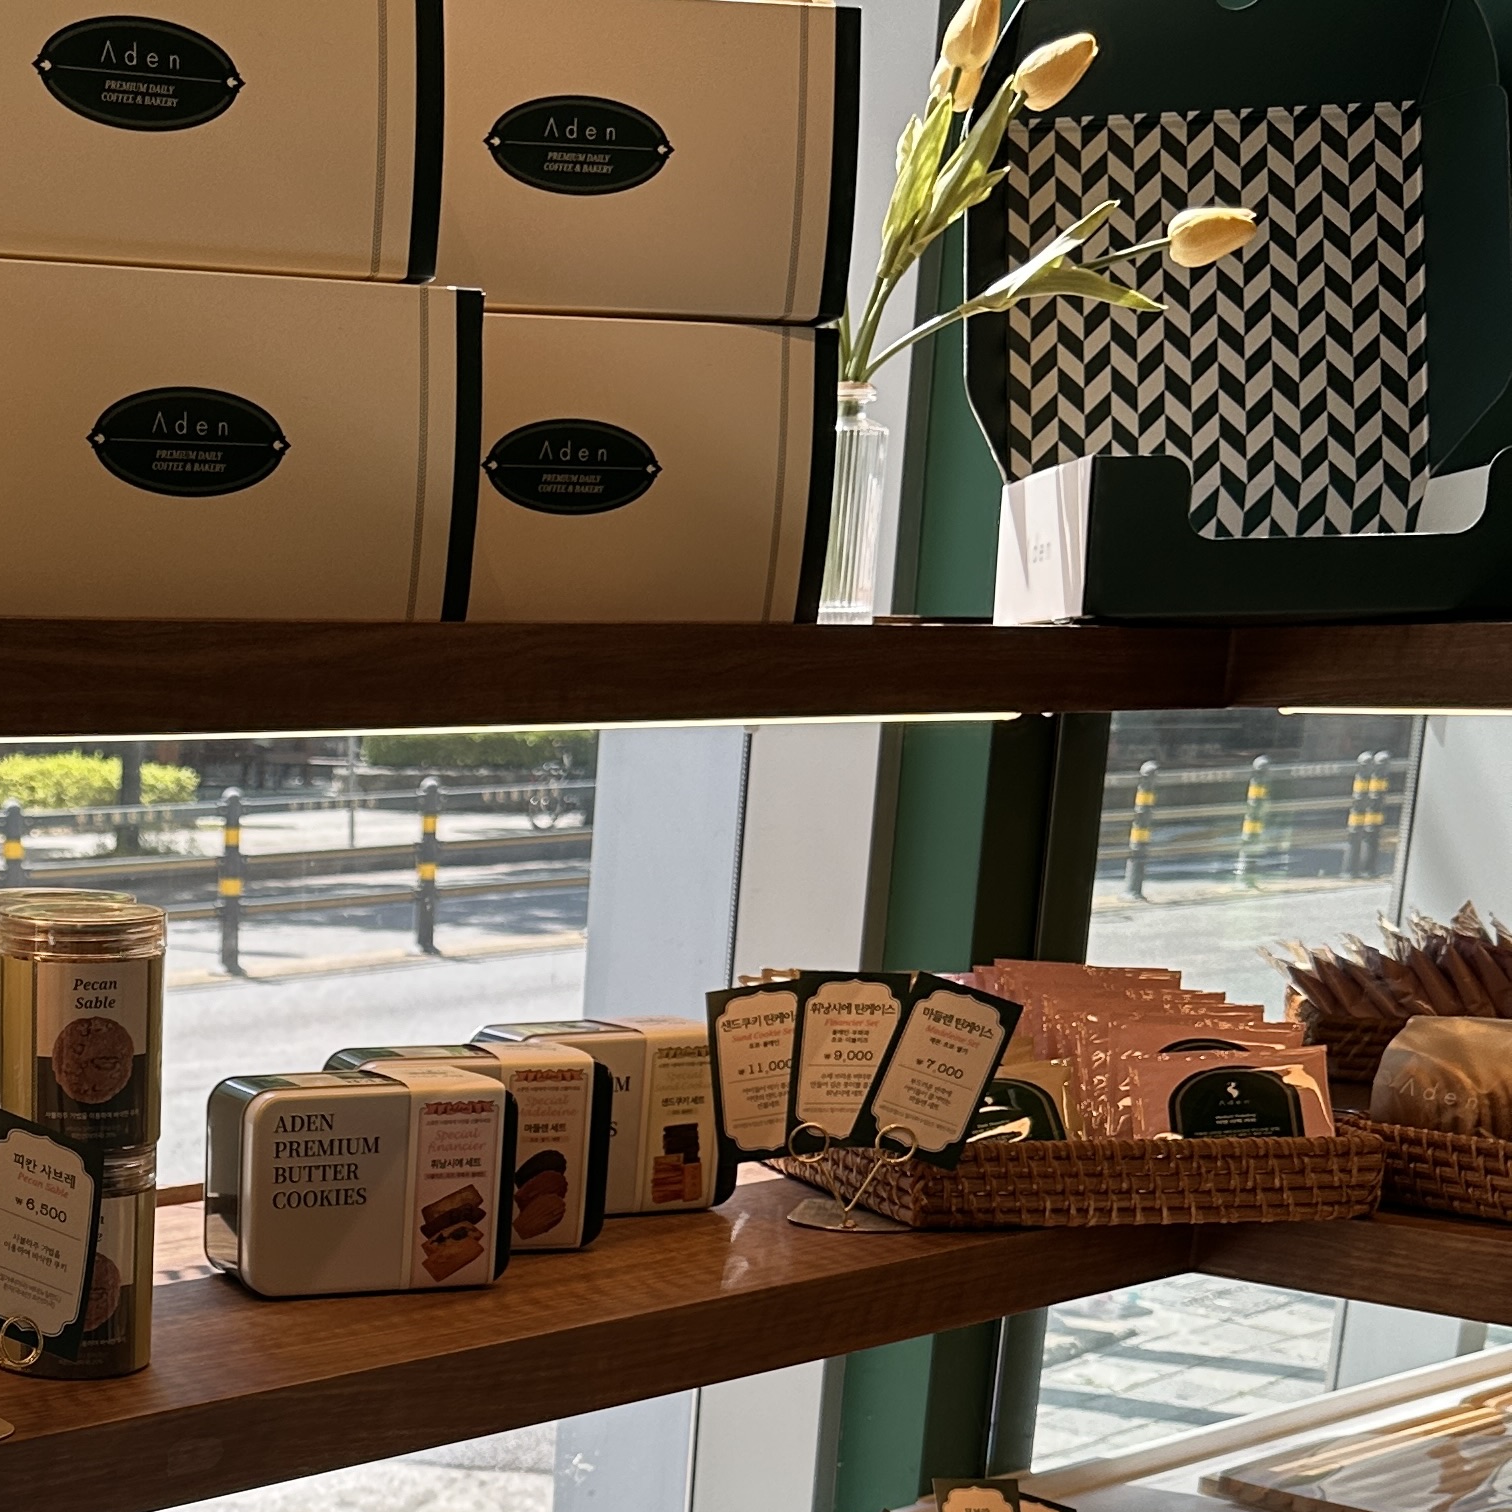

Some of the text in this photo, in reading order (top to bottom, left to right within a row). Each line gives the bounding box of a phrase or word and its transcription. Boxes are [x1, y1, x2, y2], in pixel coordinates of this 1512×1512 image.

[104, 79, 175, 95] PREMIUM DAILY
[101, 91, 135, 105] COFFEE
[144, 96, 179, 108] BAKERY
[155, 449, 224, 461] PREMIUM DAILY
[151, 461, 184, 472] COFFEE
[192, 463, 227, 474] BAKERY
[73, 978, 118, 991] Pecan
[74, 996, 116, 1010] Sable
[763, 1010, 795, 1026] 틴케이
[926, 1058, 964, 1079] 7,000
[273, 1113, 335, 1133] ADEN
[273, 1136, 380, 1158] PREMIUM
[13, 1152, 76, 1190] 피칸 사브레
[272, 1163, 360, 1184] BUTTER
[272, 1187, 367, 1210] COOKIES
[25, 1197, 68, 1224] 6,500
